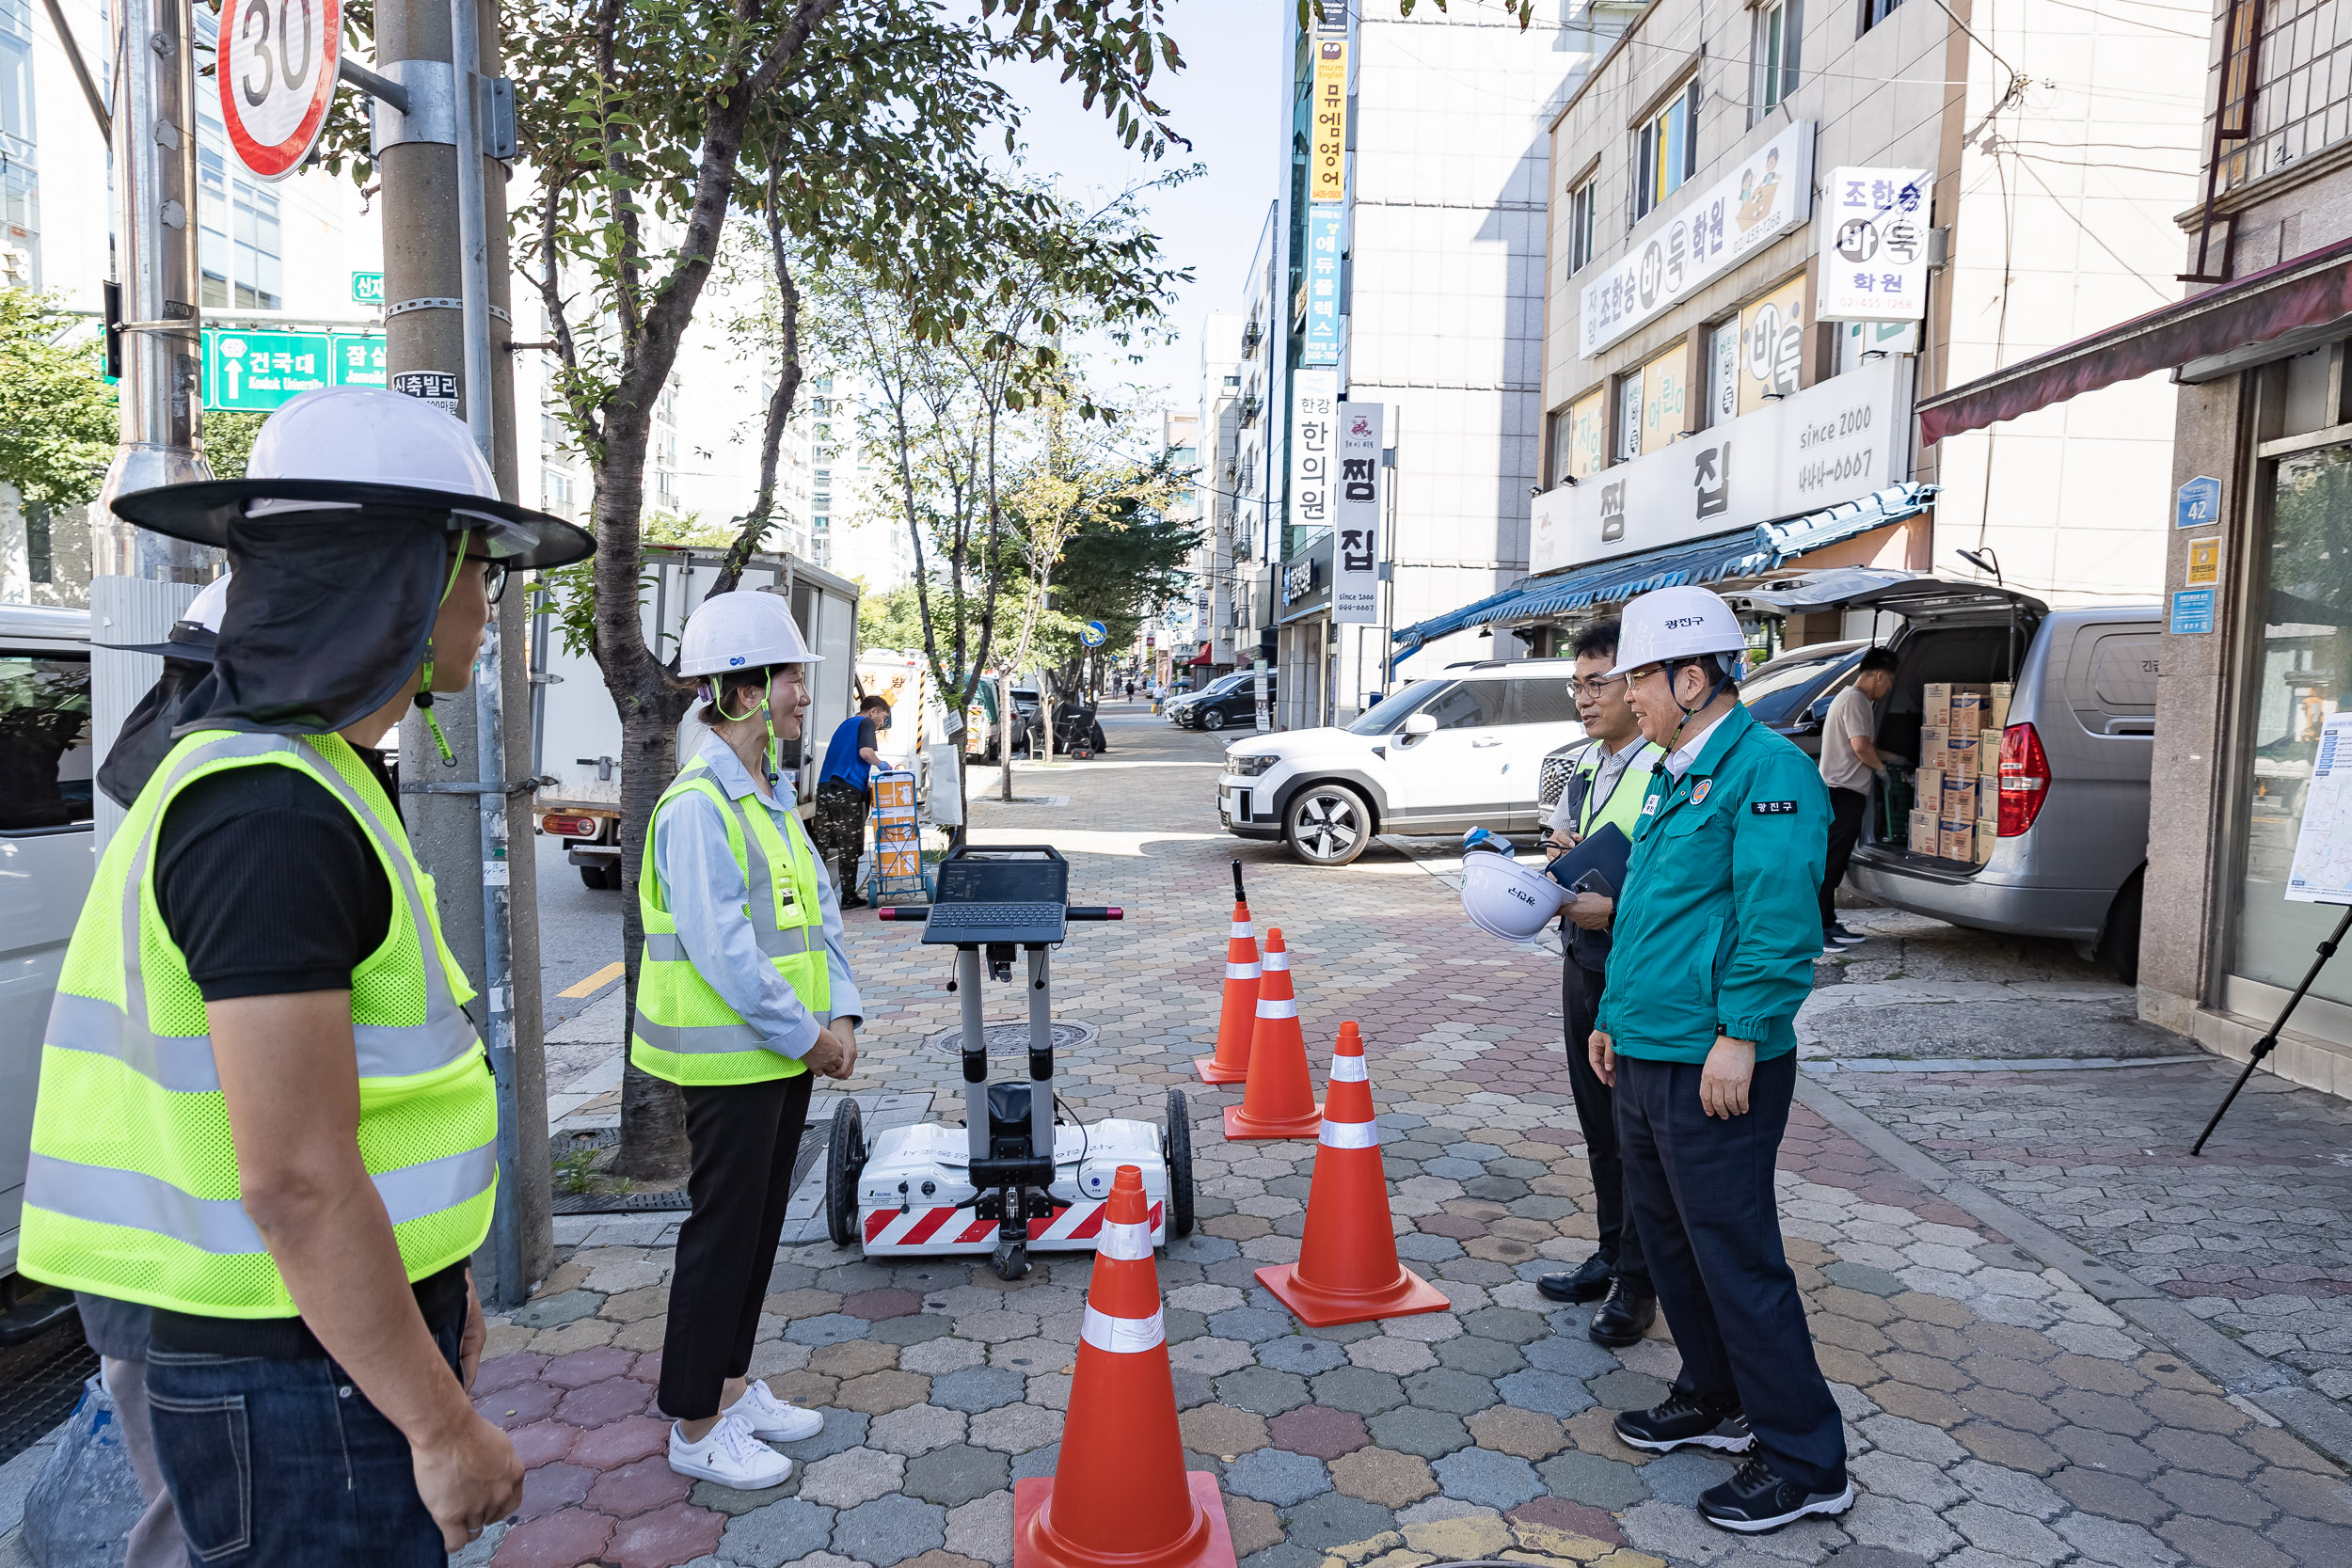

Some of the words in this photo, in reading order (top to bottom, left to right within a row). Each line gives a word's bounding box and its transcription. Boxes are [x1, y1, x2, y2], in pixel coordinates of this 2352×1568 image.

[242, 0, 311, 107] 30
[1319, 84, 1342, 186] 뮤엠영어
[1843, 180, 1921, 212] 조한승
[1838, 220, 1922, 263] 바둑
[1312, 235, 1336, 337] 에듀플렉스
[1588, 285, 1597, 346] 자양
[1600, 265, 1636, 328] 조한승
[1641, 224, 1688, 306] 바둑
[1692, 196, 1725, 263] 학원
[1853, 273, 1903, 293] 학원
[249, 352, 315, 374] 건국대
[1752, 307, 1801, 393] 바둑
[1301, 398, 1330, 415] 한강
[1800, 423, 1836, 449] since
[1839, 404, 1871, 436] 2000
[1299, 420, 1328, 520] 한의원
[1799, 448, 1872, 493] 444-0007
[1341, 458, 1376, 573] 찜집
[2187, 500, 2207, 520] 42
[1338, 603, 1375, 612] 444-0007
[1339, 593, 1357, 601] since
[1664, 616, 1705, 629] 광진구
[430, 723, 444, 748] SAFETY
[1756, 801, 1792, 812] 광진구
[1507, 887, 1536, 907] 광진구
